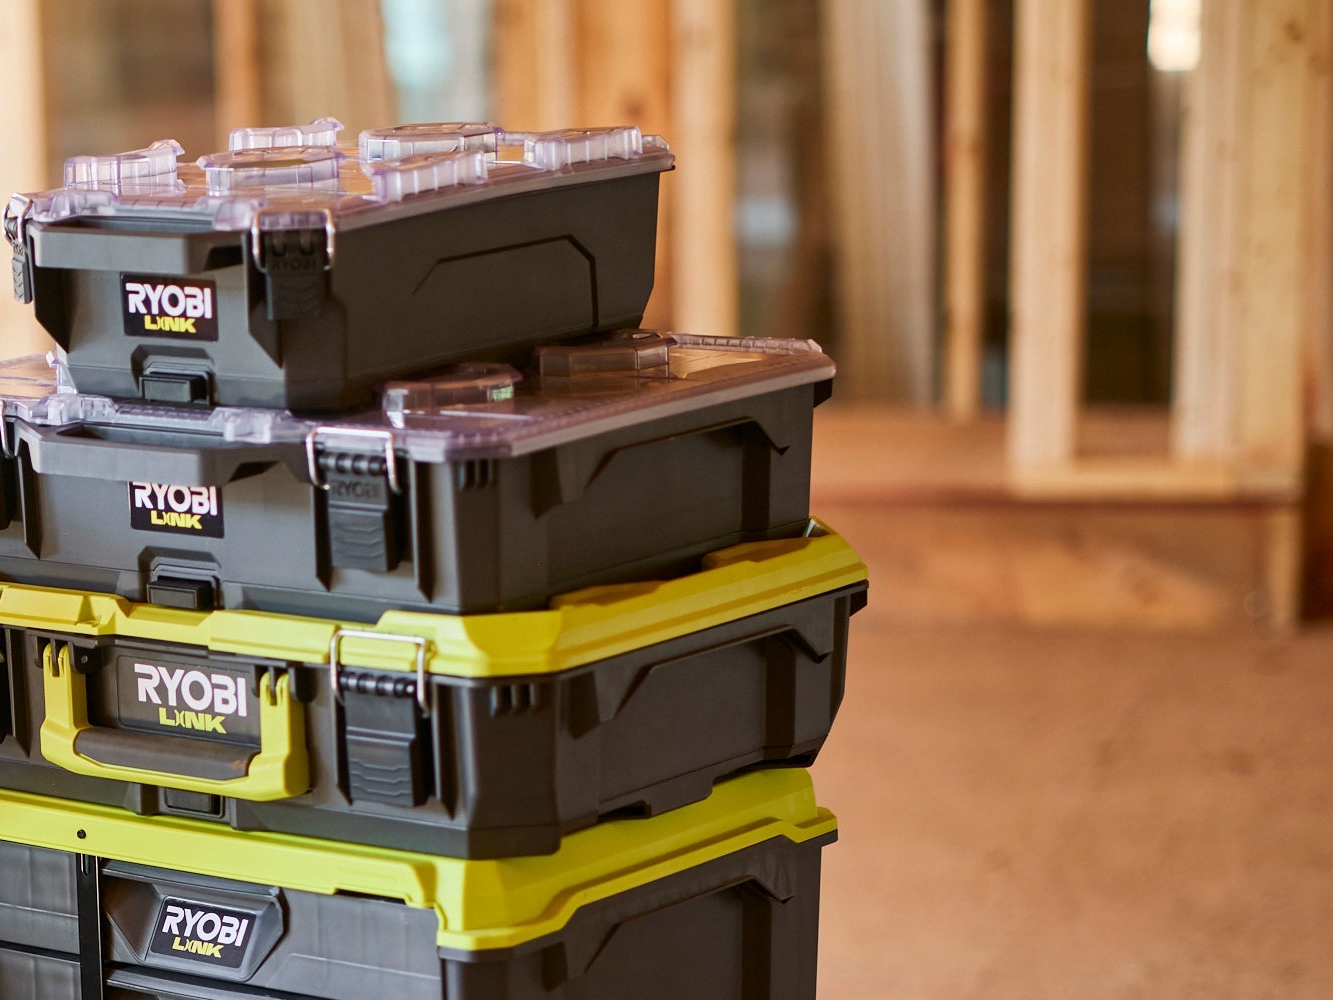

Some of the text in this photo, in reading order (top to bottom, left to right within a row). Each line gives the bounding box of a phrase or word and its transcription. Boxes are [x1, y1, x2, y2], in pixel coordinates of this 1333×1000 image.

[125, 282, 213, 319] RYOBI
[133, 481, 218, 516] RYOBI
[134, 663, 247, 717] RYOBI
[162, 905, 249, 947] RYOBI
